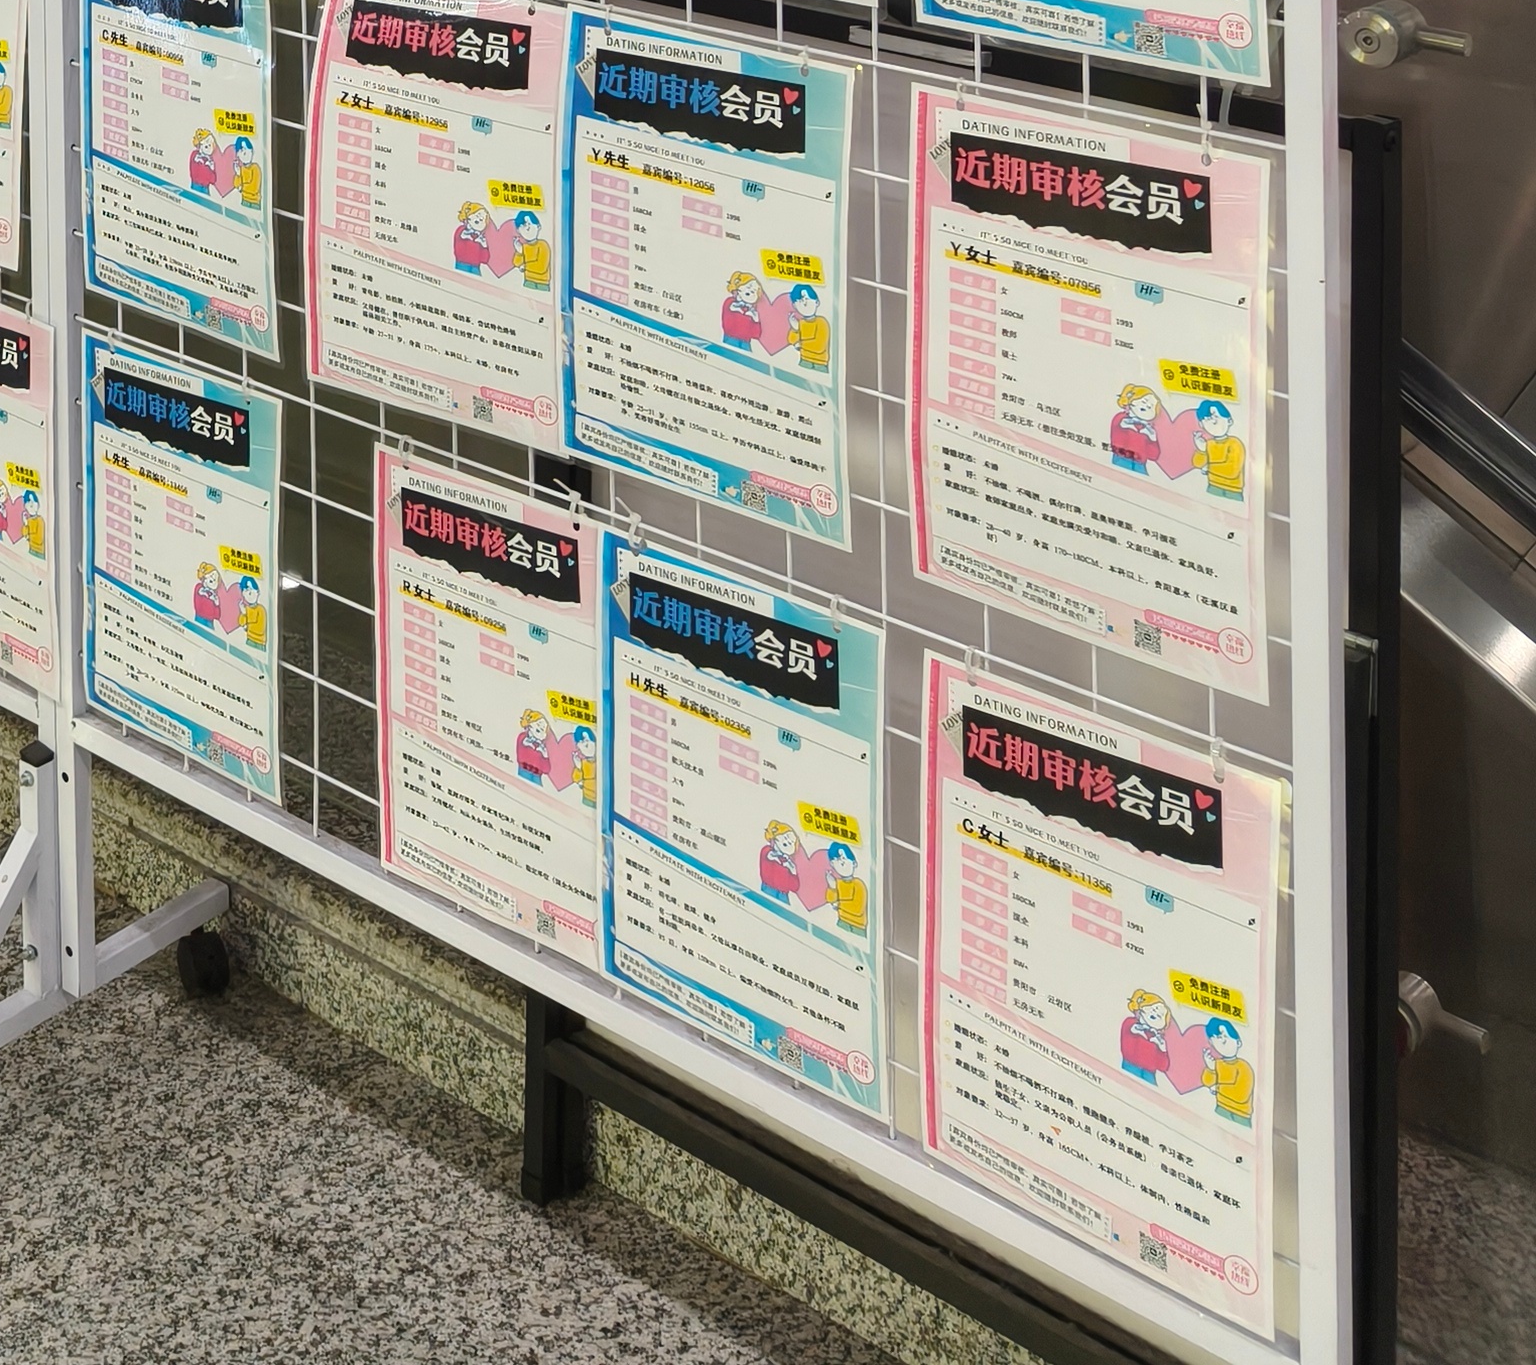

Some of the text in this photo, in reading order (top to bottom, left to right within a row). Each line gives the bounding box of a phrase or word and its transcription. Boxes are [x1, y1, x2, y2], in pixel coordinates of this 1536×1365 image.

[351, 10, 511, 69] 近期审核会员
[605, 35, 722, 66] DATING INFORMATION
[598, 60, 783, 131] 近期审核会员
[962, 117, 1106, 154] DATING INFORMATION
[955, 145, 1183, 227] 近期审核会员
[106, 377, 234, 448] 近期审核会员
[404, 498, 560, 580] 近期审核会员
[633, 584, 817, 684] 近期审核会员
[975, 692, 1117, 751] DATING INFORMATION
[967, 719, 1194, 838] 近期审核会员
